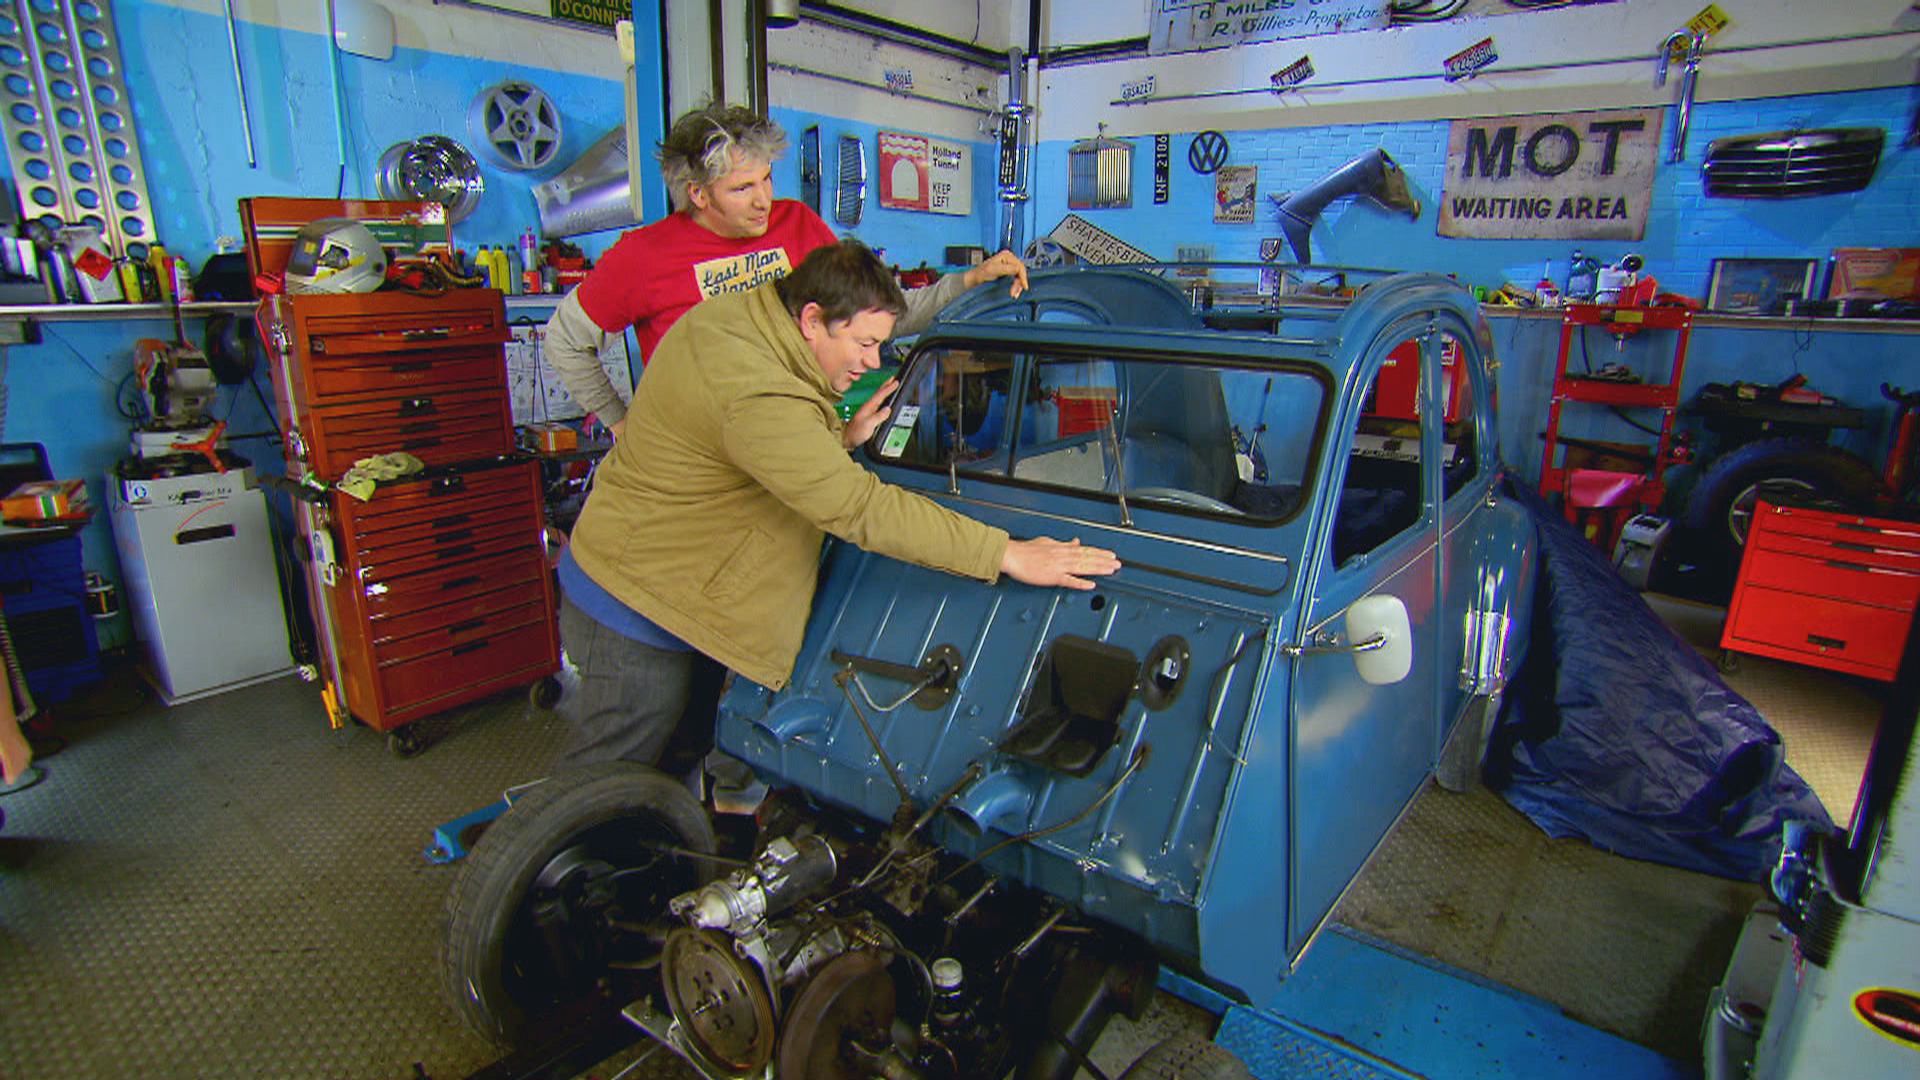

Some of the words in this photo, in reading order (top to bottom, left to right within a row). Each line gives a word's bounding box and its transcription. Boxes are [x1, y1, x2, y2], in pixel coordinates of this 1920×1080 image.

[932, 145, 962, 160] Holland
[1156, 135, 1168, 168] 2106
[1461, 120, 1646, 179] MOT
[932, 158, 960, 171] Tunnel
[932, 182, 952, 196] KEEP
[932, 195, 951, 208] LEFT
[1452, 197, 1551, 220] WAITING
[1556, 196, 1628, 220] AREA
[1066, 218, 1146, 263] SHAFTESBU
[1072, 241, 1116, 264] AVEN
[703, 266, 739, 290] Last
[744, 250, 780, 273] Man
